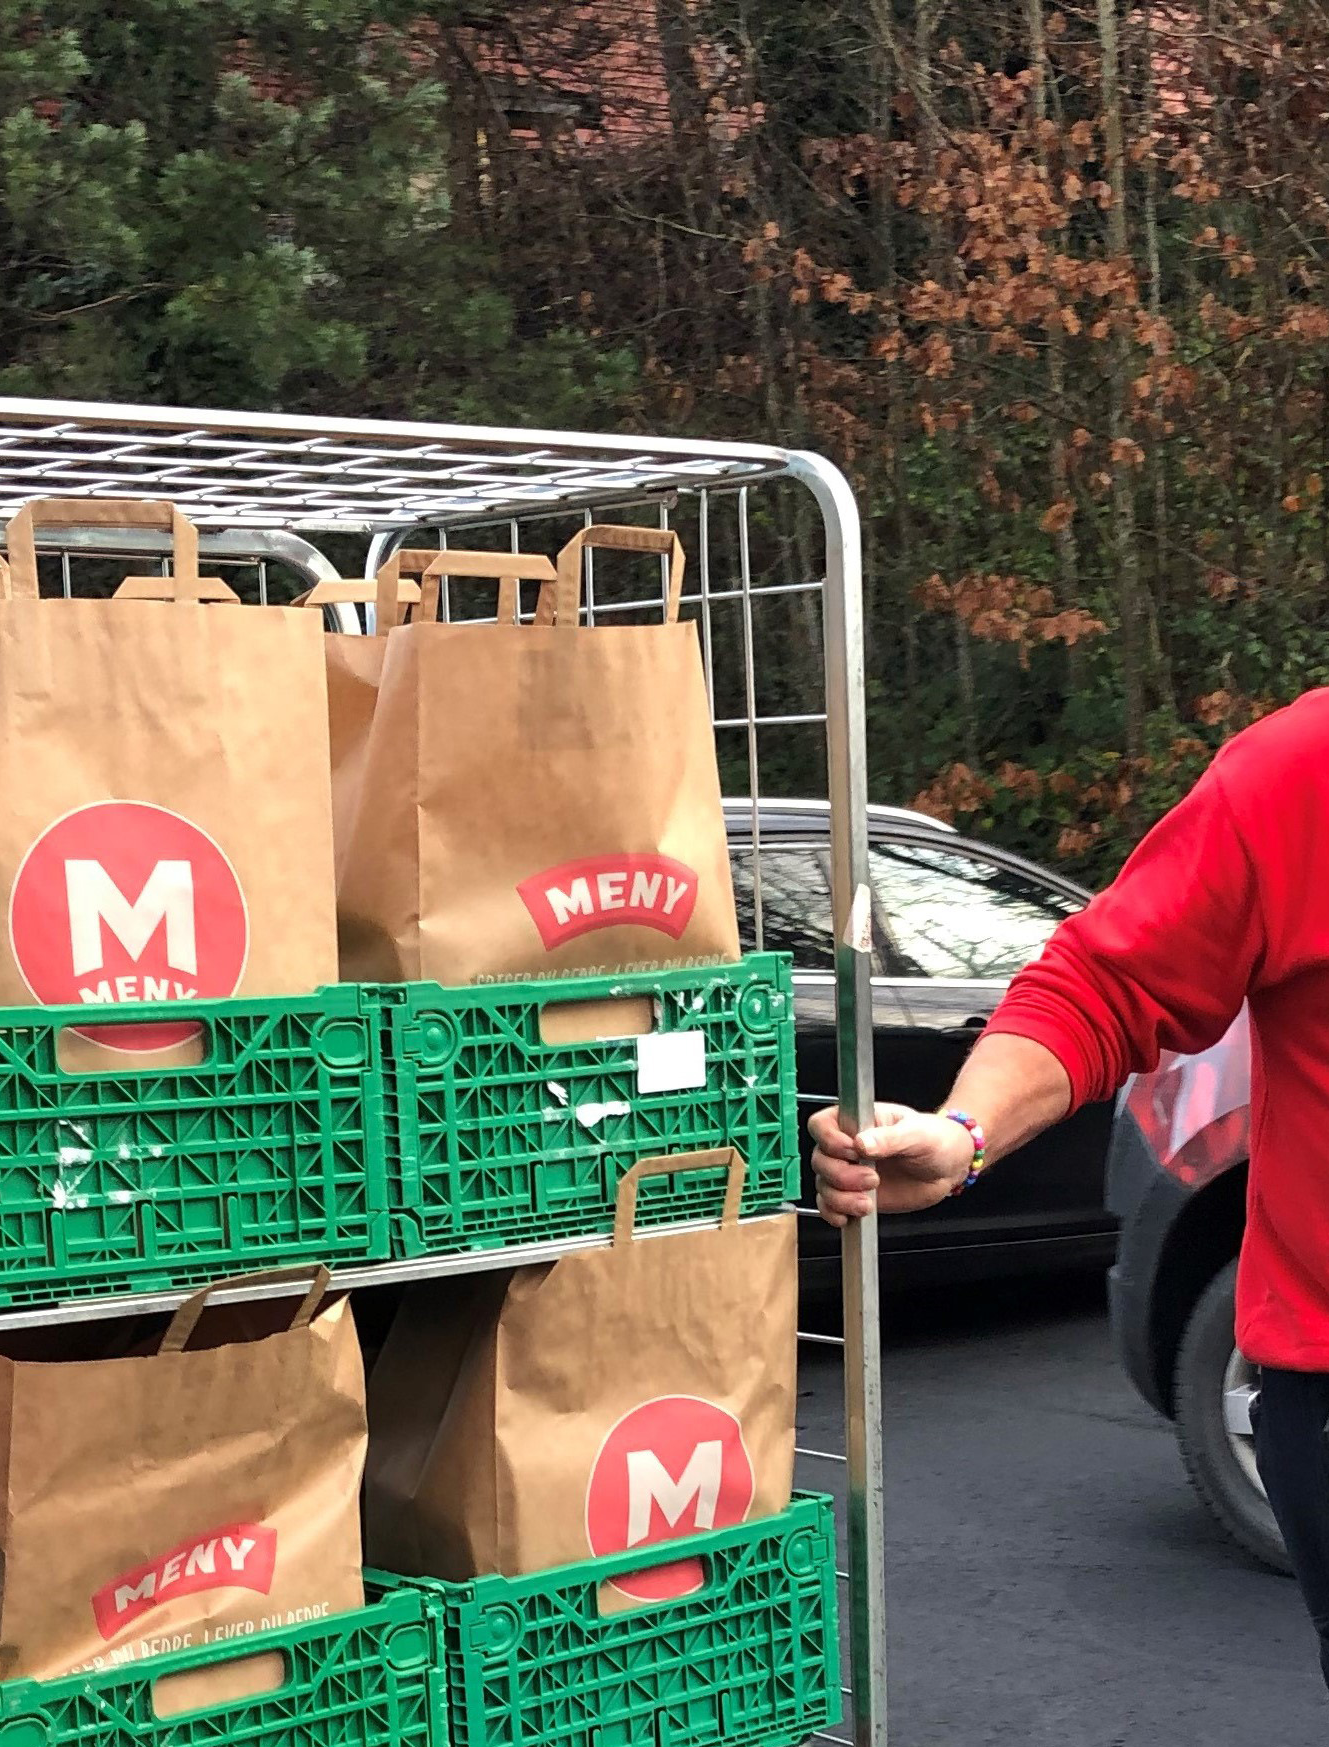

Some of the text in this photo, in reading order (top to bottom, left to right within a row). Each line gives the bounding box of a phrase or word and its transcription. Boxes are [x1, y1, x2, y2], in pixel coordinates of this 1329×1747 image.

[64, 859, 198, 977] M
[544, 871, 689, 926] MENY
[626, 1439, 722, 1549] M
[114, 1536, 257, 1613] MENY
